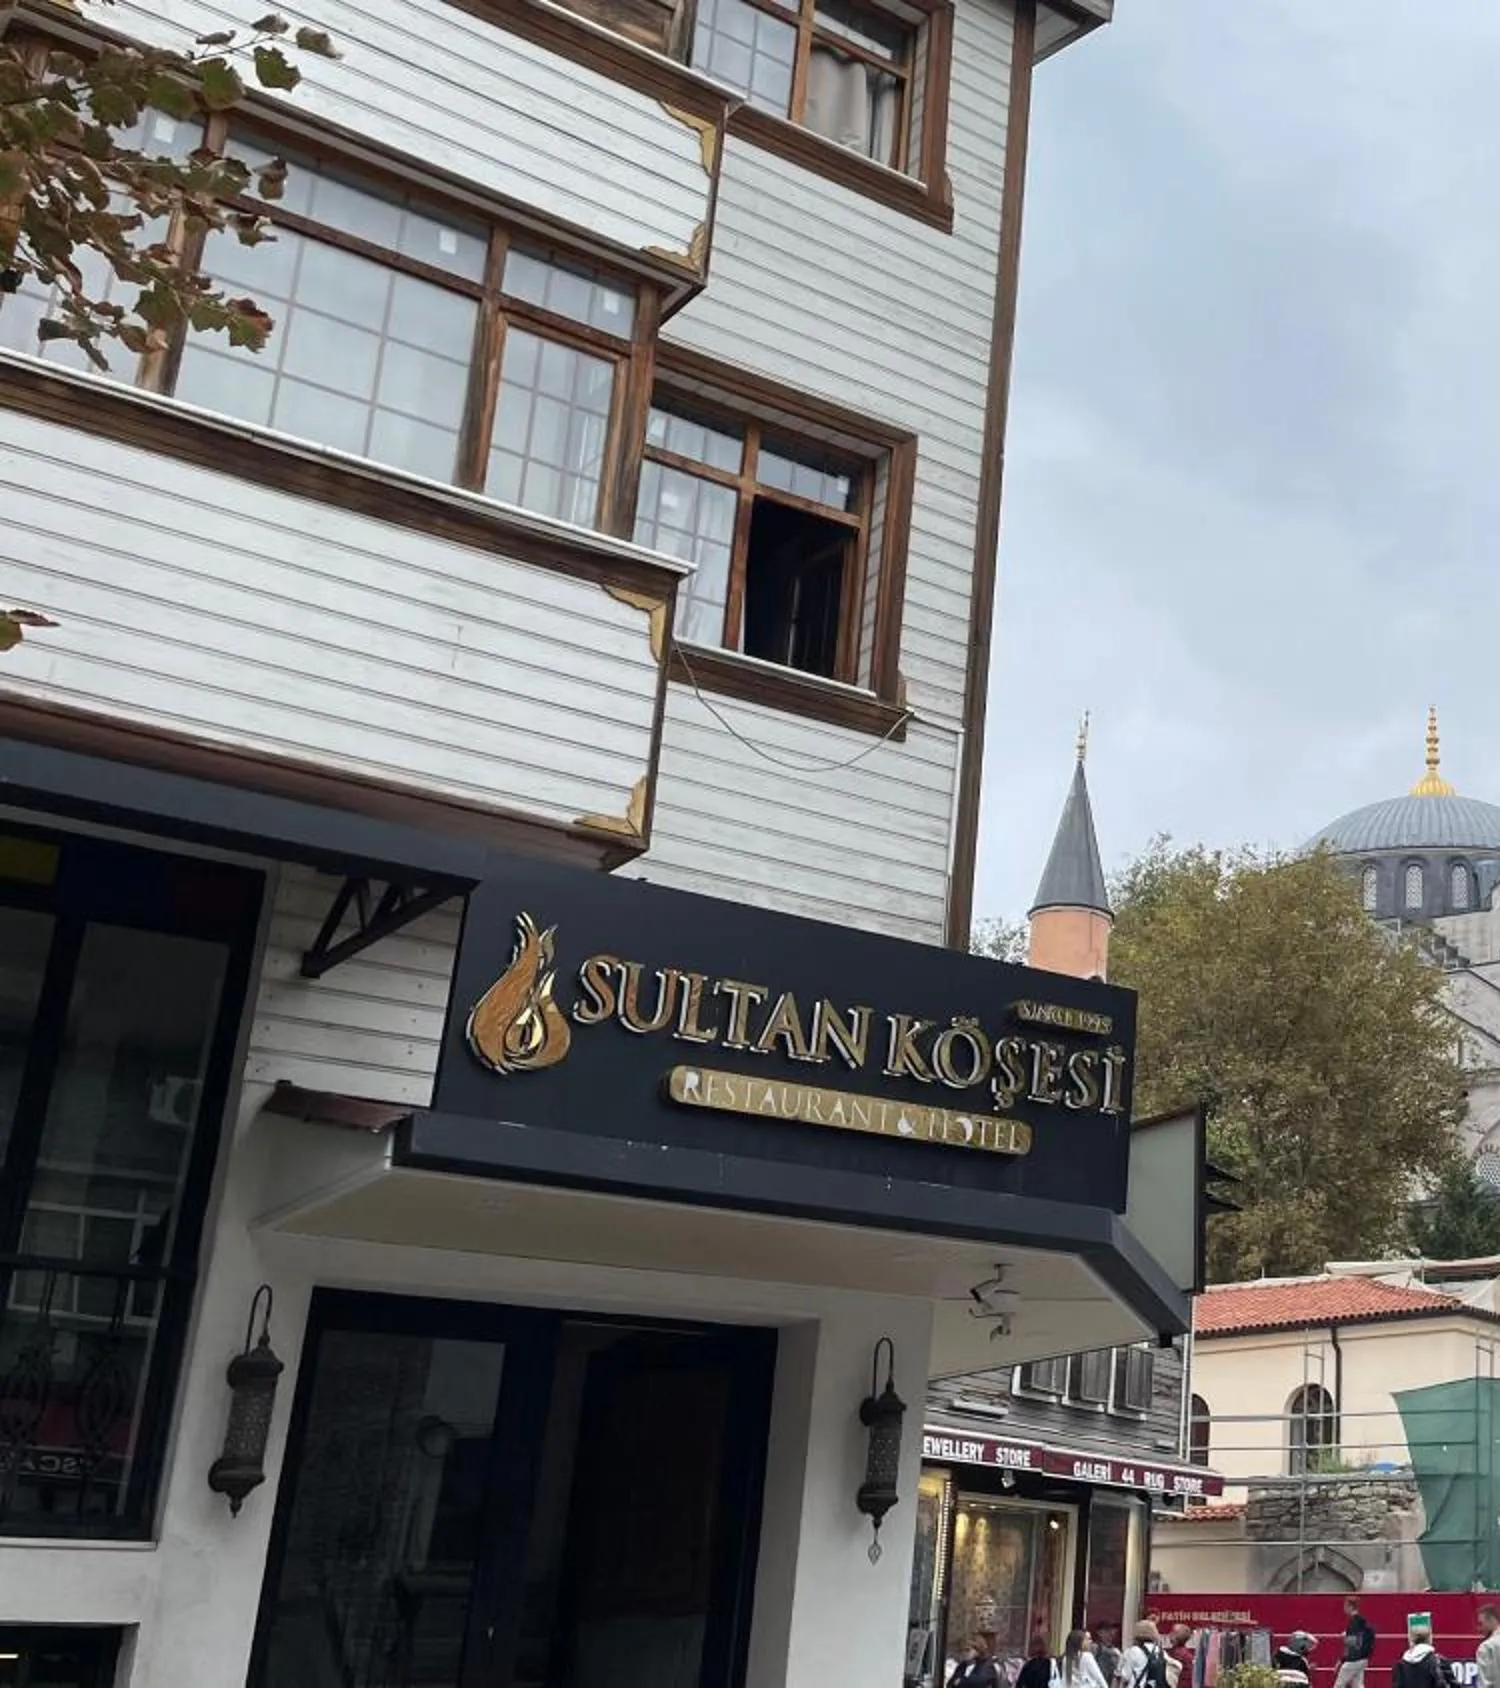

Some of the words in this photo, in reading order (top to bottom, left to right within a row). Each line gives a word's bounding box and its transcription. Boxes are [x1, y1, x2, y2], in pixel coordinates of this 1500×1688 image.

[573, 954, 874, 1069] SULTAN
[883, 1013, 1126, 1114] KÖŞESİ
[683, 1070, 891, 1131] RESTAURANT
[928, 1108, 1025, 1151] HOTEL
[923, 1437, 984, 1461] EWELLERY
[996, 1448, 1031, 1467] STORE
[1143, 1473, 1165, 1490] RUG
[1173, 1476, 1203, 1493] STORE
